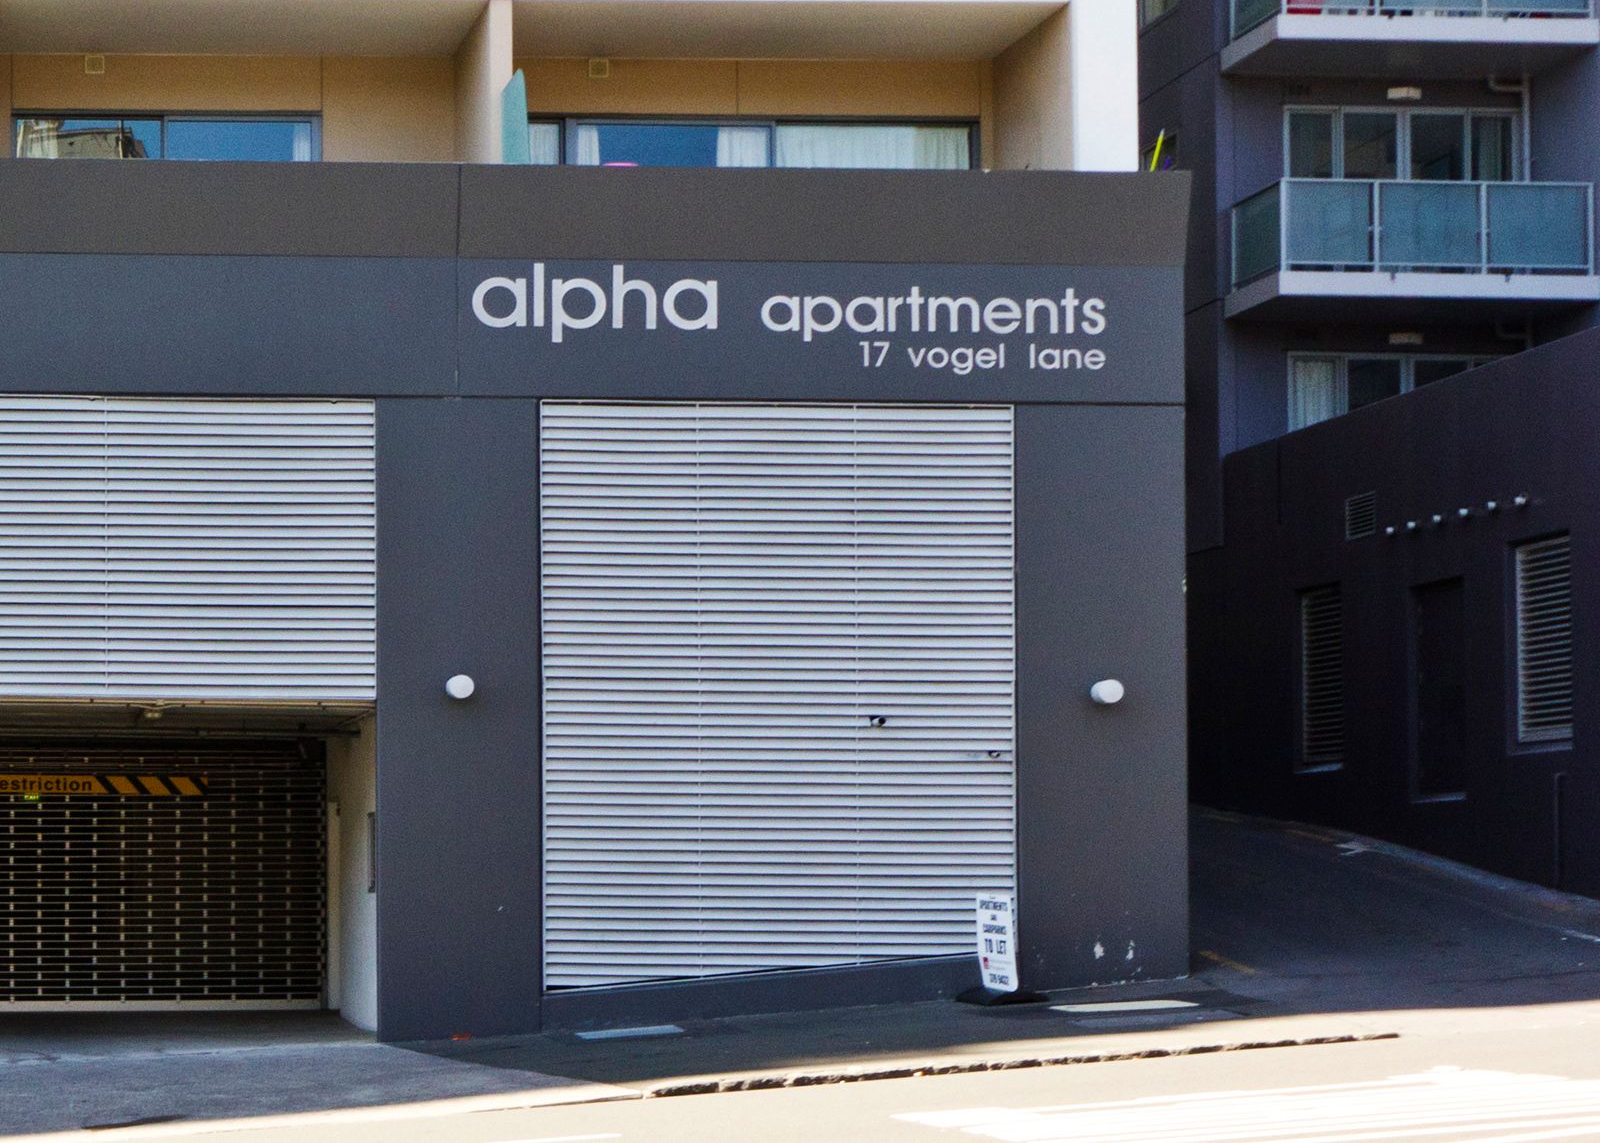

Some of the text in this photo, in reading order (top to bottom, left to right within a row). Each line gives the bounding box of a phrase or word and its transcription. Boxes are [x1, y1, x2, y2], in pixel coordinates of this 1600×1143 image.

[472, 263, 1106, 343] alpha apartments
[859, 341, 1106, 376] 17 vogel lane
[984, 938, 1007, 955] TO LET
